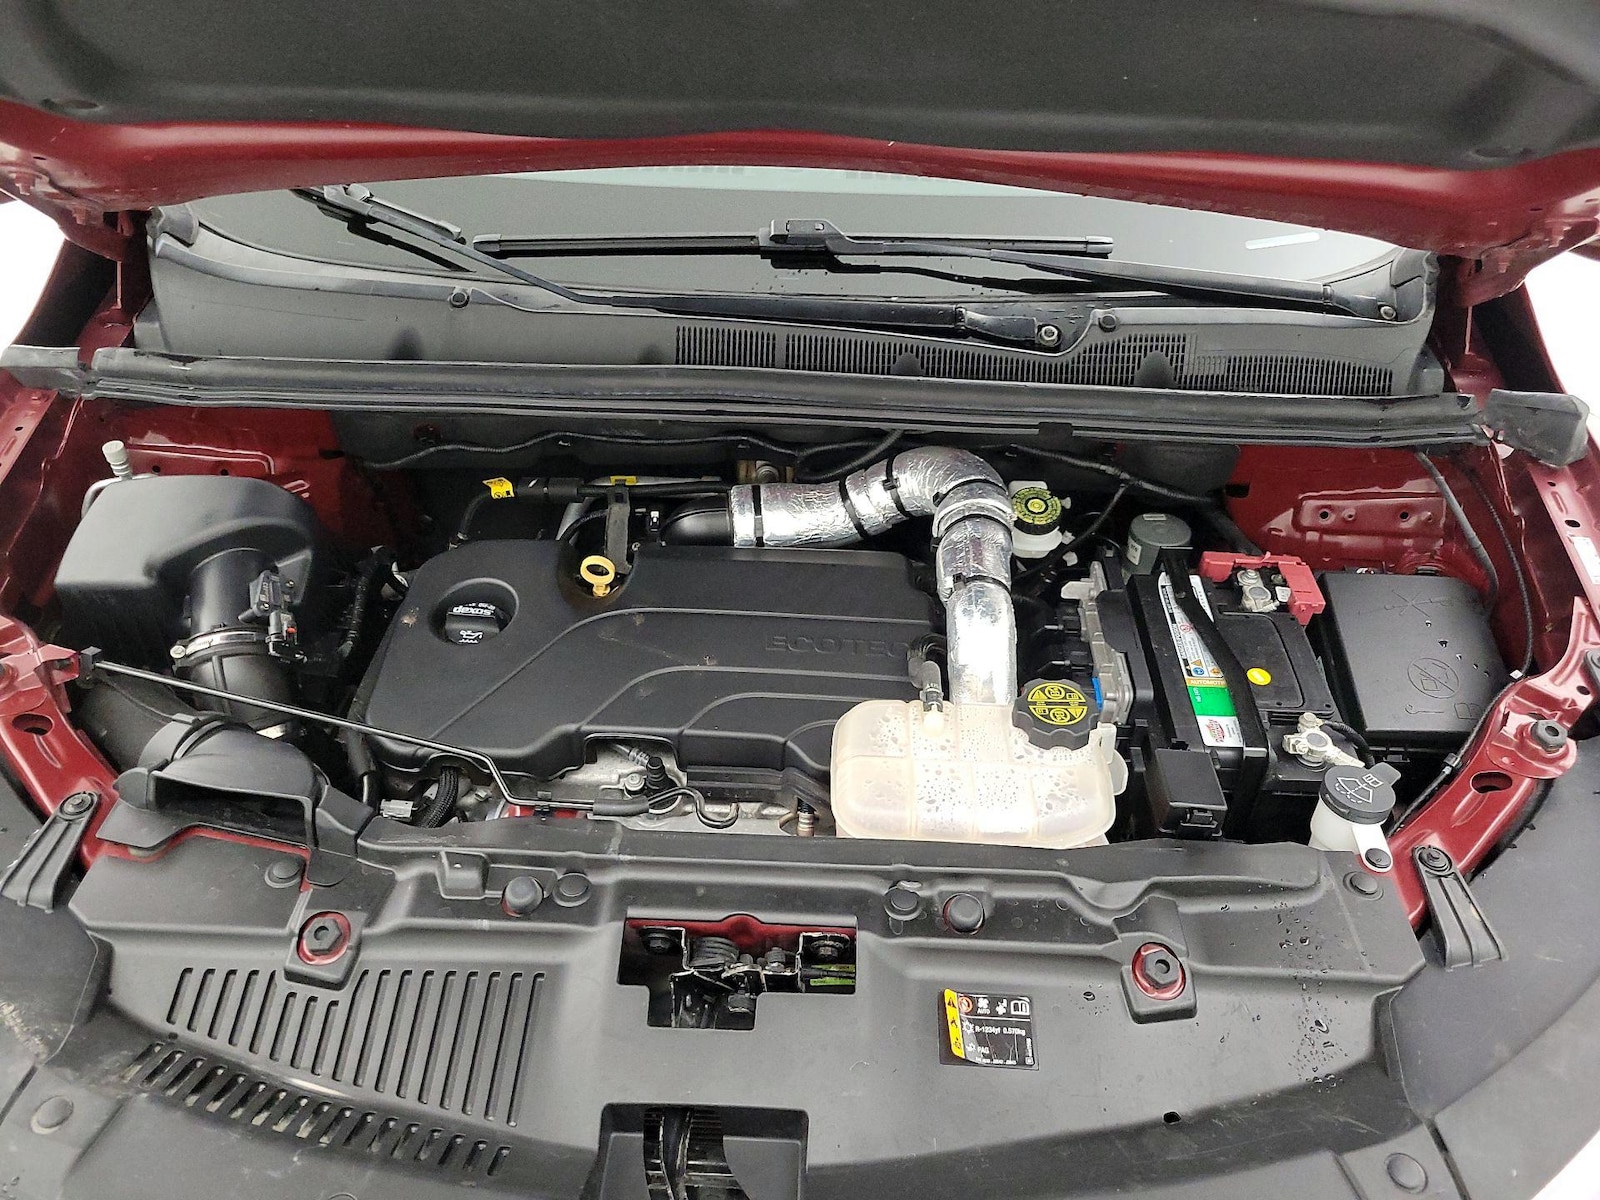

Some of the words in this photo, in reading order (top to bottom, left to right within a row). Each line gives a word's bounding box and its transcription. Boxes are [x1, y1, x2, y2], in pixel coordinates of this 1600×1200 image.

[453, 605, 492, 616] dexos
[765, 636, 909, 658] ECOTEC
[975, 1025, 1001, 1035] R-1234yf
[977, 1046, 989, 1054] PAG
